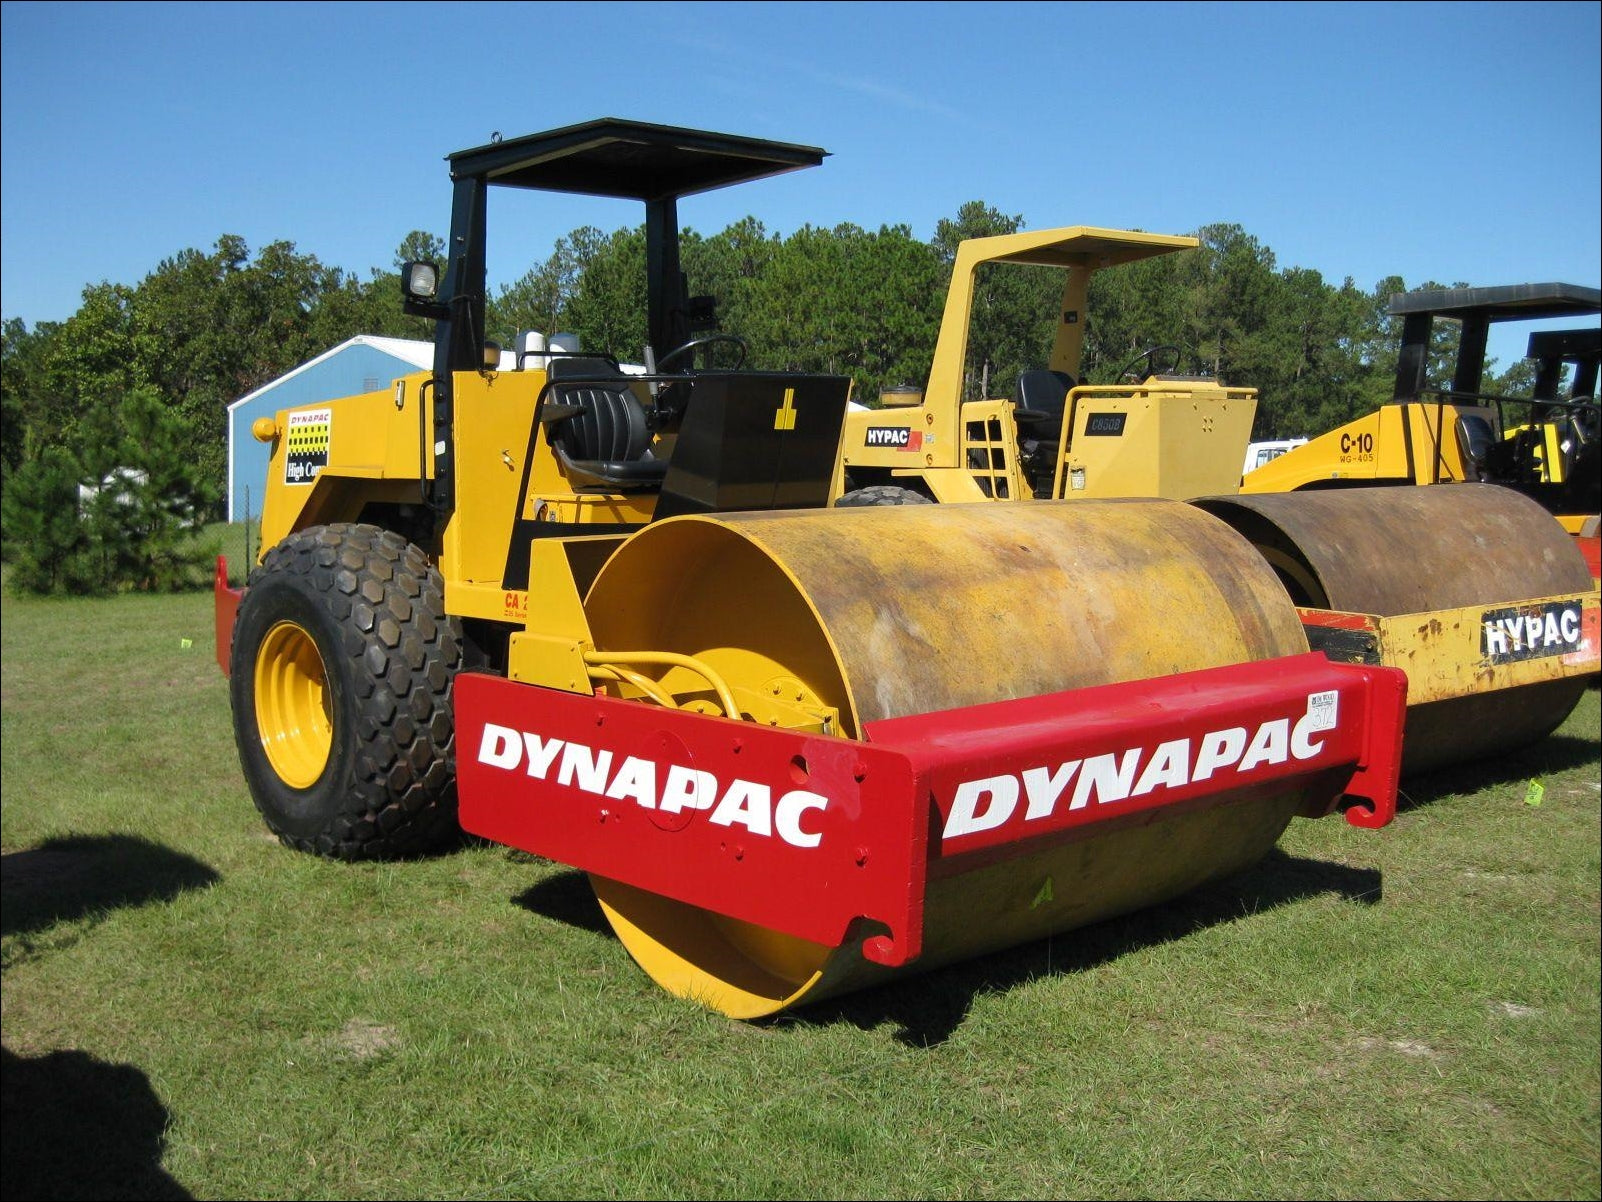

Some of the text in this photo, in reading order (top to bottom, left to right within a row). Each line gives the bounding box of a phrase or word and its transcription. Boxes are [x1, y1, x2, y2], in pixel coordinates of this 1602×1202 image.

[291, 413, 329, 424] DYNAPAC
[867, 429, 908, 444] HYPAC
[1340, 433, 1373, 454] C-10
[1340, 453, 1374, 463] WG-405
[287, 462, 304, 481] High
[505, 592, 519, 609] CA
[1485, 609, 1579, 655] HYPAC
[477, 722, 829, 848] DYNAPAC
[942, 714, 1325, 839] DYNAPAC
